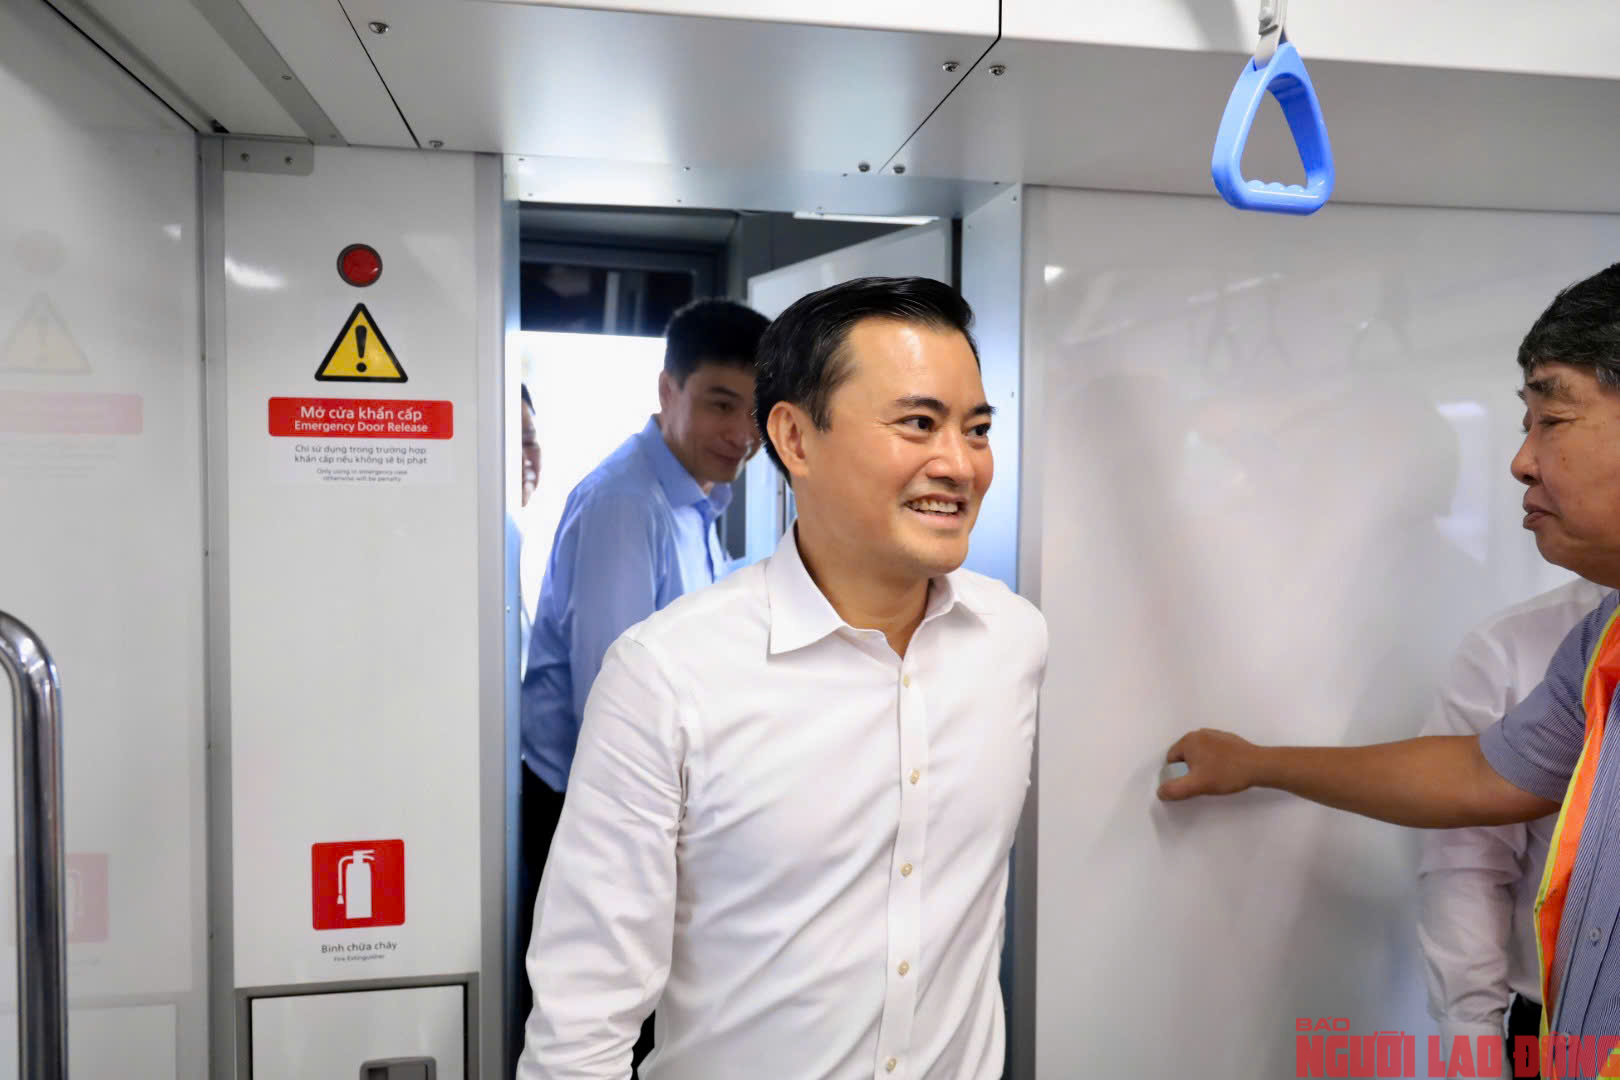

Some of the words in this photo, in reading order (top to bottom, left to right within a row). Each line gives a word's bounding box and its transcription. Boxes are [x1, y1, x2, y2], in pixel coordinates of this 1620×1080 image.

[301, 406, 325, 418] Mở
[329, 406, 354, 419] cửa
[359, 406, 393, 420] khẩn
[397, 407, 422, 422] cấp
[294, 421, 354, 433] Emergency
[358, 422, 384, 432] Door
[388, 422, 428, 432] Release
[350, 446, 373, 455] trong
[355, 455, 382, 465] không
